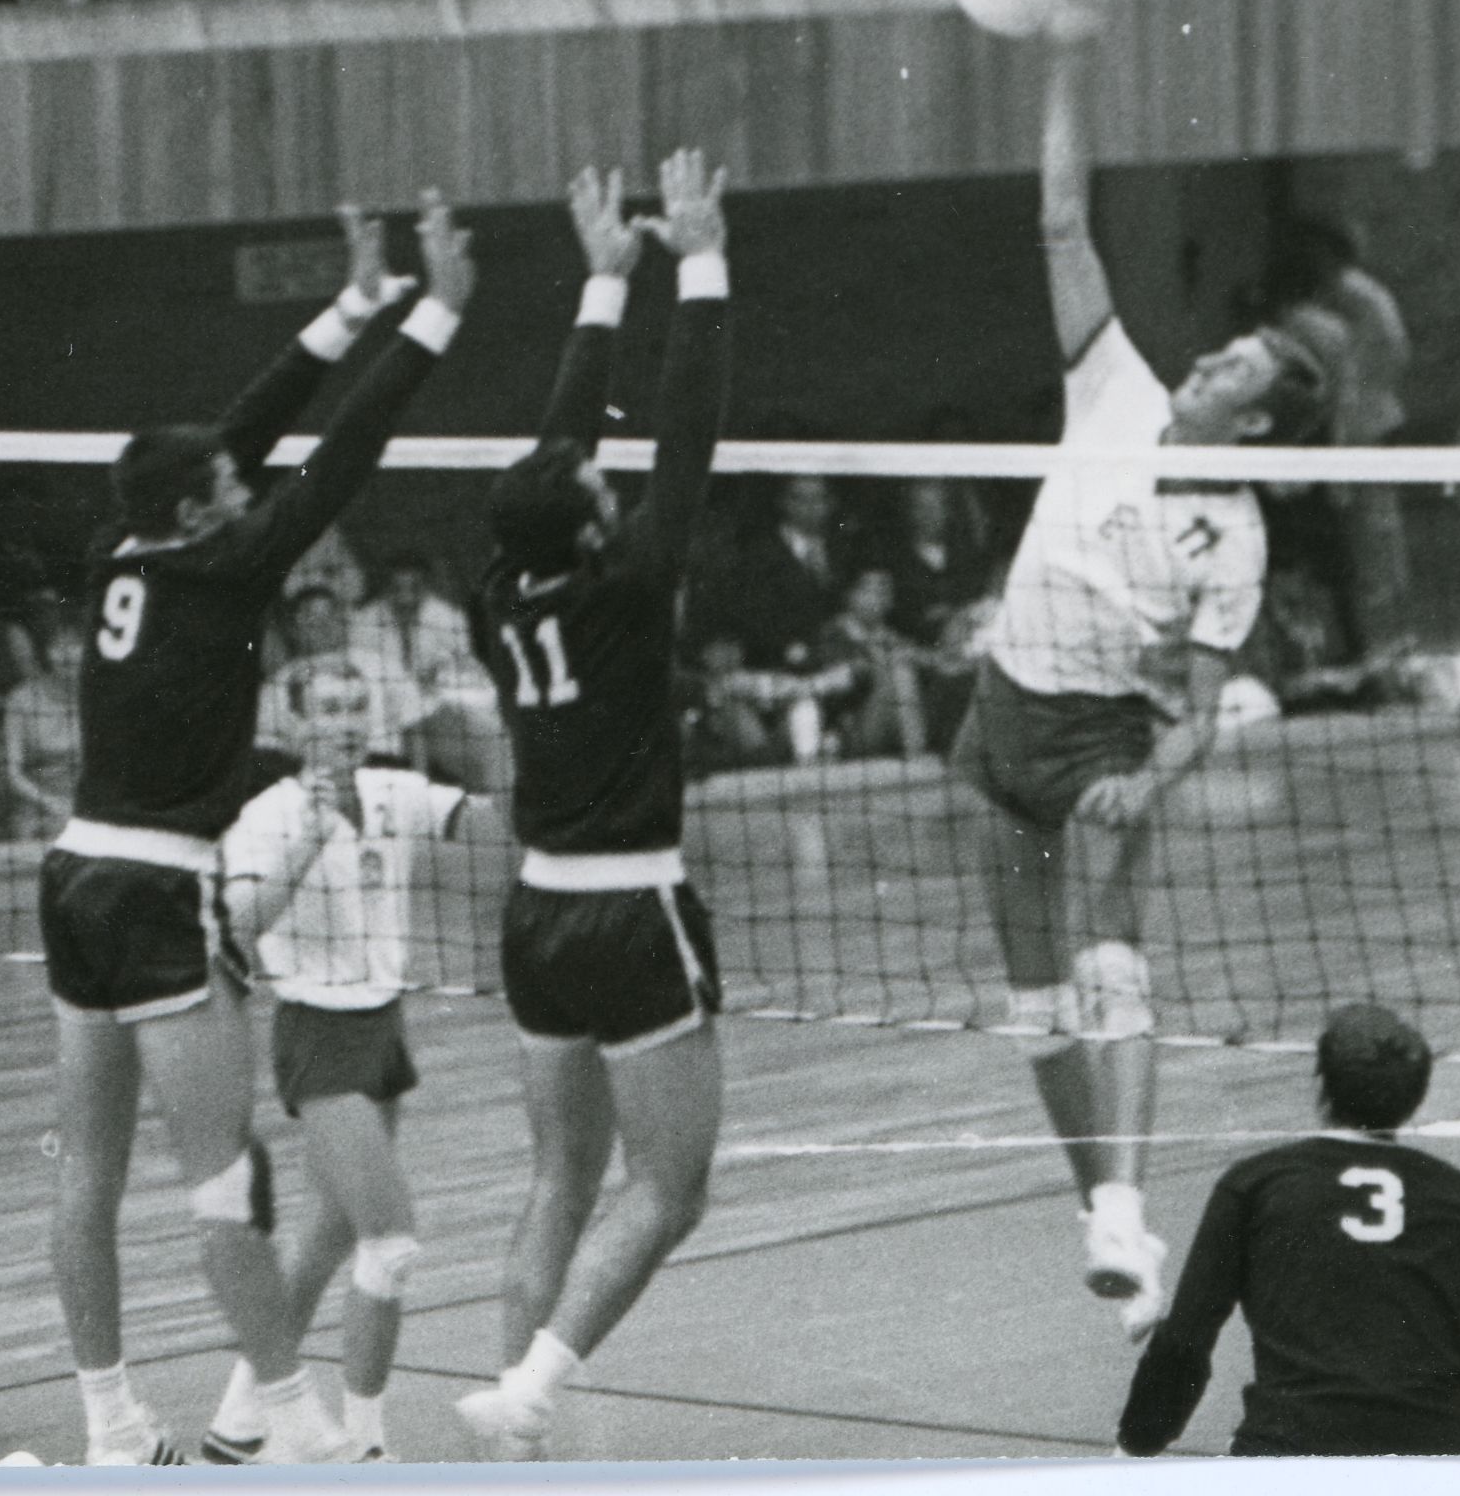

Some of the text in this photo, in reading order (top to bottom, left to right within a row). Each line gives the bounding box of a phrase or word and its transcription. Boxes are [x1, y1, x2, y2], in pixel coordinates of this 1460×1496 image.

[97, 574, 145, 661] 9
[500, 616, 581, 706] 11
[1338, 1166, 1405, 1243] 3
